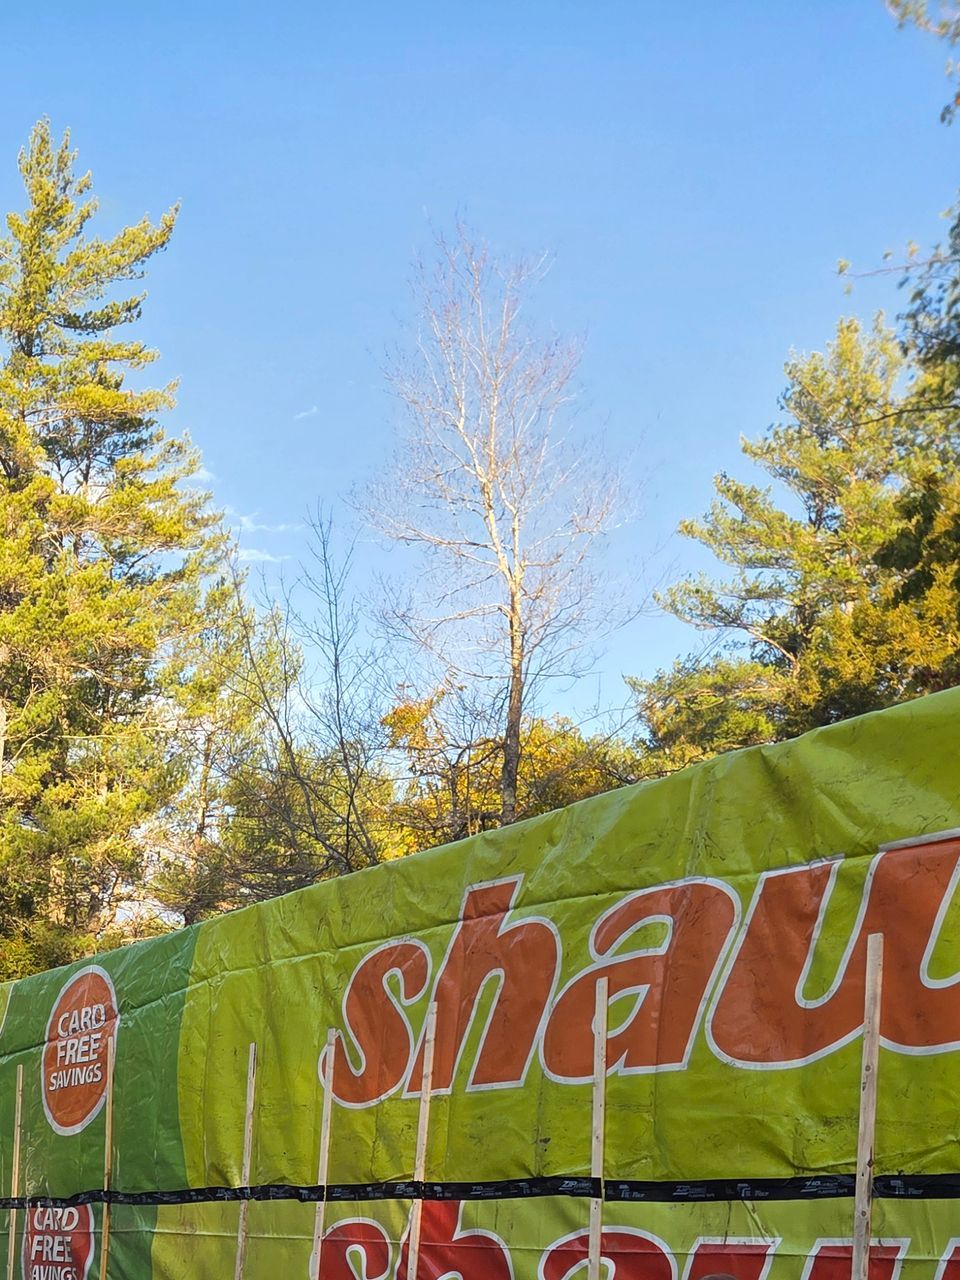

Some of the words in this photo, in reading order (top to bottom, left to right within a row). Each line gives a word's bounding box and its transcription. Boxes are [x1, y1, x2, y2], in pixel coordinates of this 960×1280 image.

[58, 1004, 106, 1038] CARD
[57, 1033, 102, 1067] FREE
[49, 1063, 102, 1091] SAVINGS
[34, 1206, 79, 1231] CARD
[31, 1235, 73, 1262] FREE
